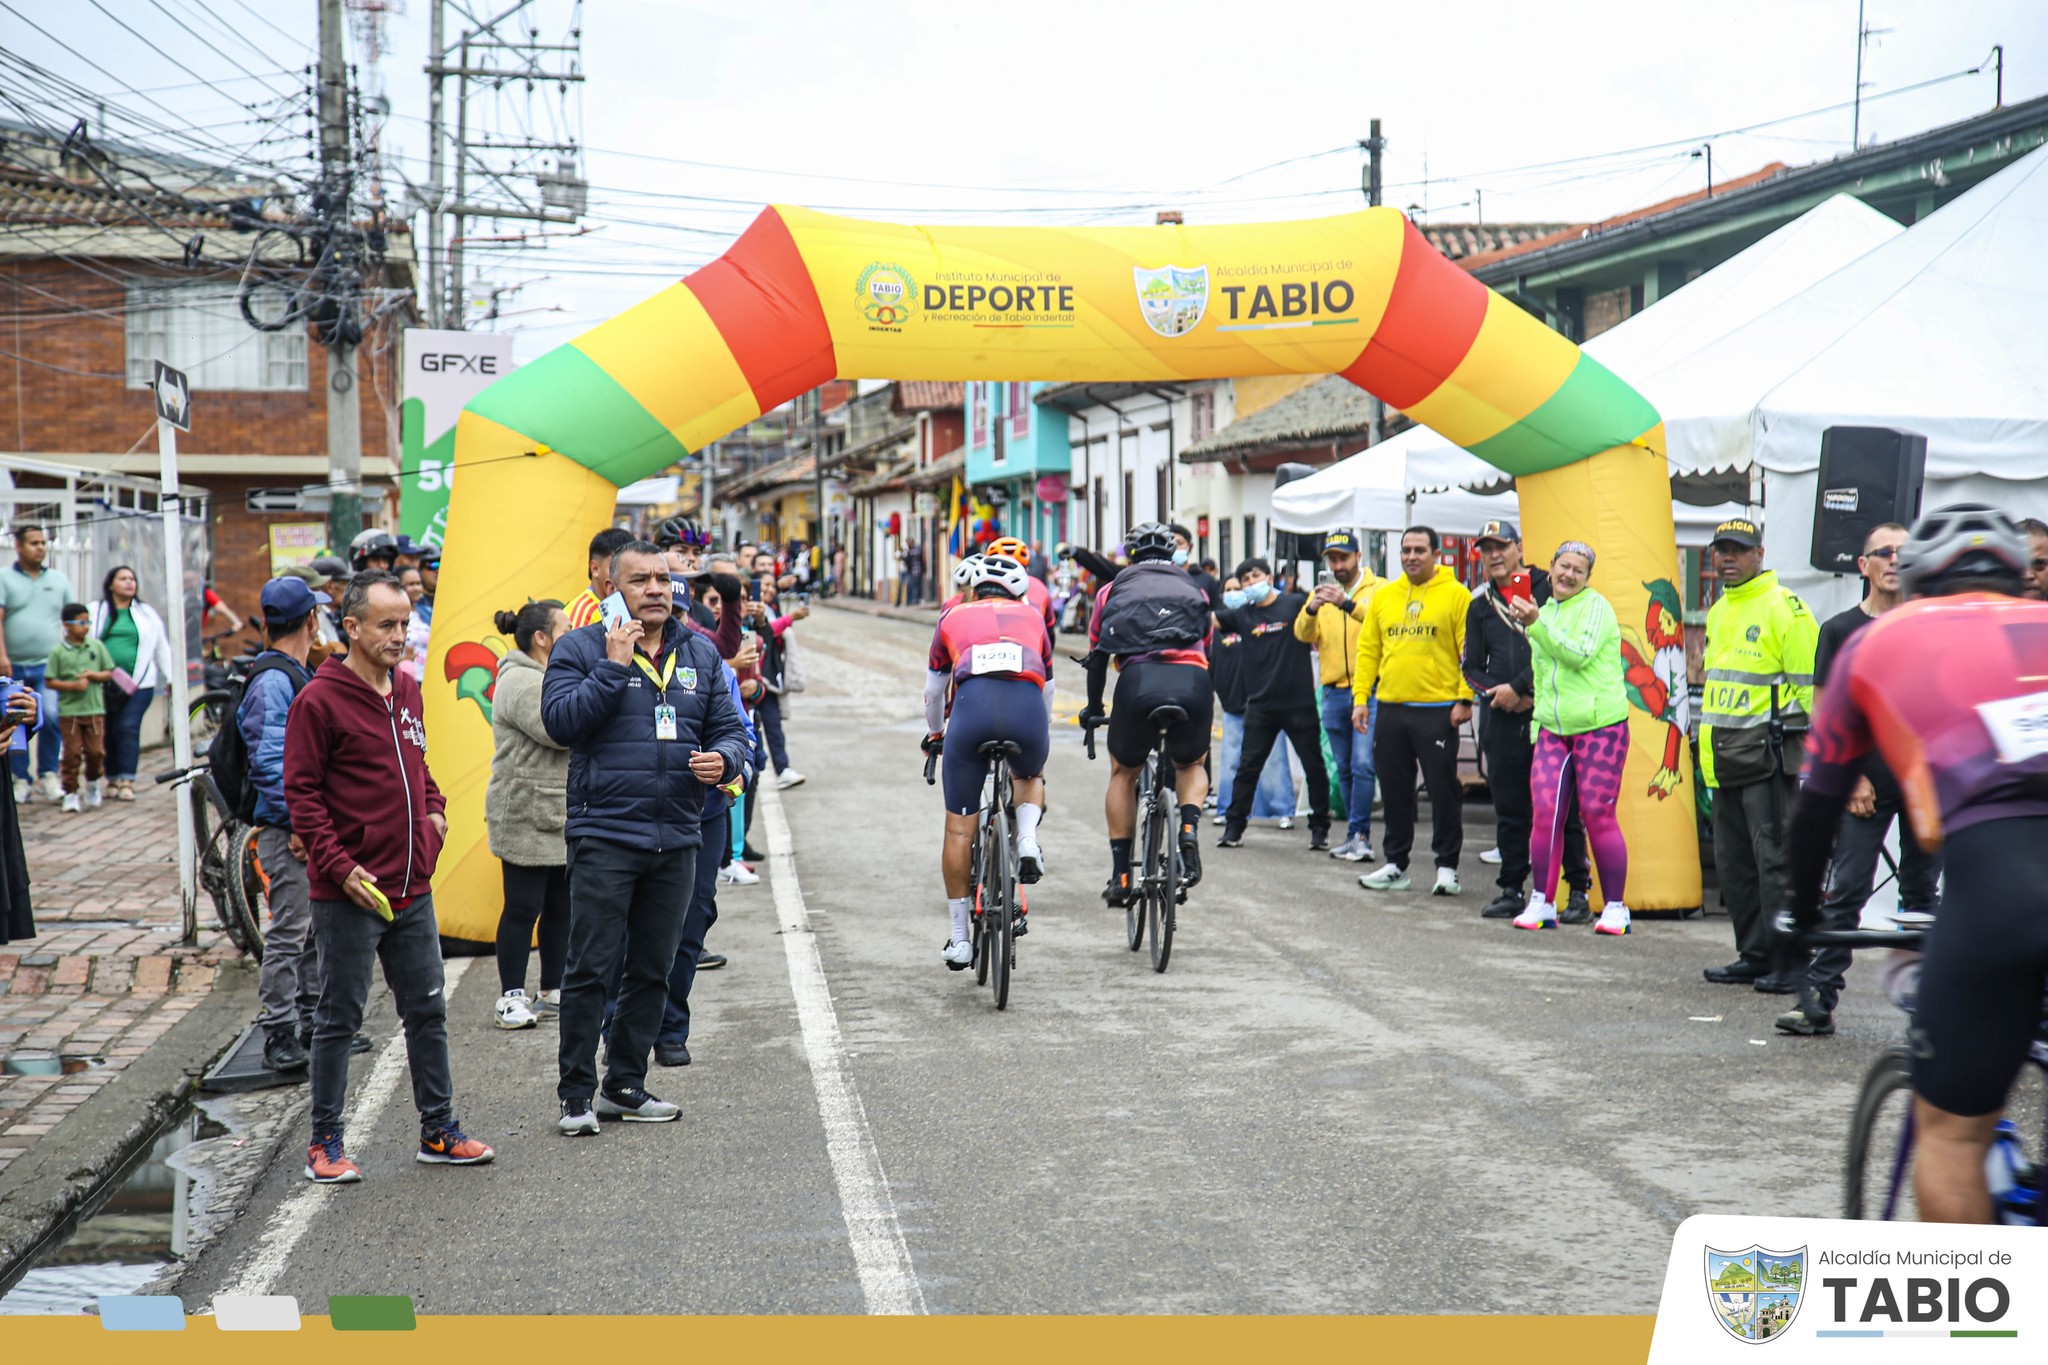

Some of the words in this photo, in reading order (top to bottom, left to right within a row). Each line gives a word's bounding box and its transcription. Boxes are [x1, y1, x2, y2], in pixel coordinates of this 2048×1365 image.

[1272, 260, 1333, 275] Municipal
[1336, 258, 1353, 270] de
[935, 271, 982, 282] Instituto
[986, 272, 1043, 284] Municipal
[1046, 272, 1061, 282] de
[872, 283, 902, 294] TABIO
[924, 284, 1074, 311] DEPORTE
[1221, 279, 1355, 320] TABIO
[923, 313, 928, 322] y
[931, 311, 985, 322] Recreación
[989, 312, 1001, 322] de
[1004, 312, 1031, 322] Tabio
[1033, 312, 1075, 322] Indertab
[420, 353, 497, 375] GFXE
[1387, 625, 1438, 637] DEPORTE
[977, 652, 1016, 660] 4293
